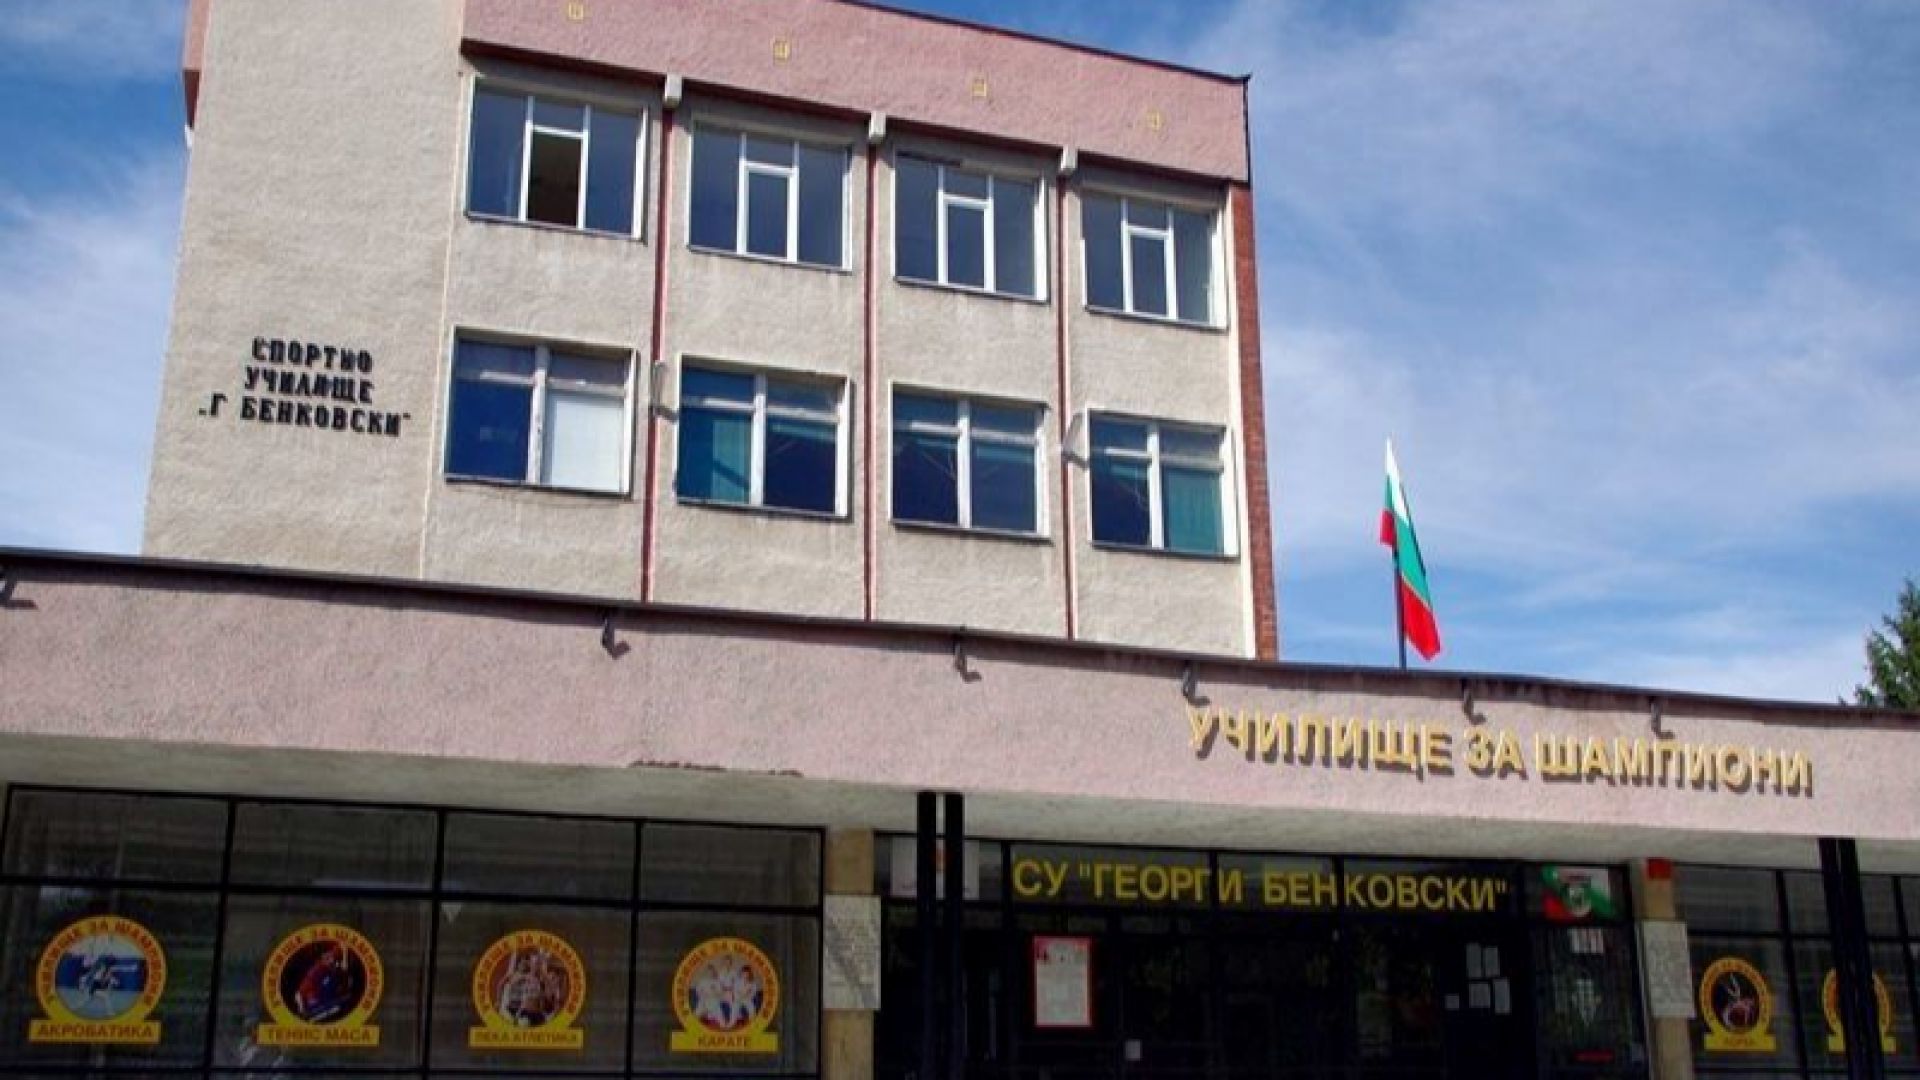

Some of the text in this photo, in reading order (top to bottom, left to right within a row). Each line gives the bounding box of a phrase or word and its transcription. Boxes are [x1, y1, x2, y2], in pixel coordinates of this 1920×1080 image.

[245, 365, 375, 404] УЧИЛИЩЕ
[1187, 703, 1813, 797] УЧИЛИЩЕ ЗА ШАМПИОНИ
[1012, 858, 1508, 911] СУ "ГЕОРГИ БЕНКОВСКИ"
[38, 1025, 153, 1038] АКРОБАТИКА
[267, 1028, 371, 1041] ТЕНИС МАСА
[698, 1036, 752, 1047] КАРАТЕ
